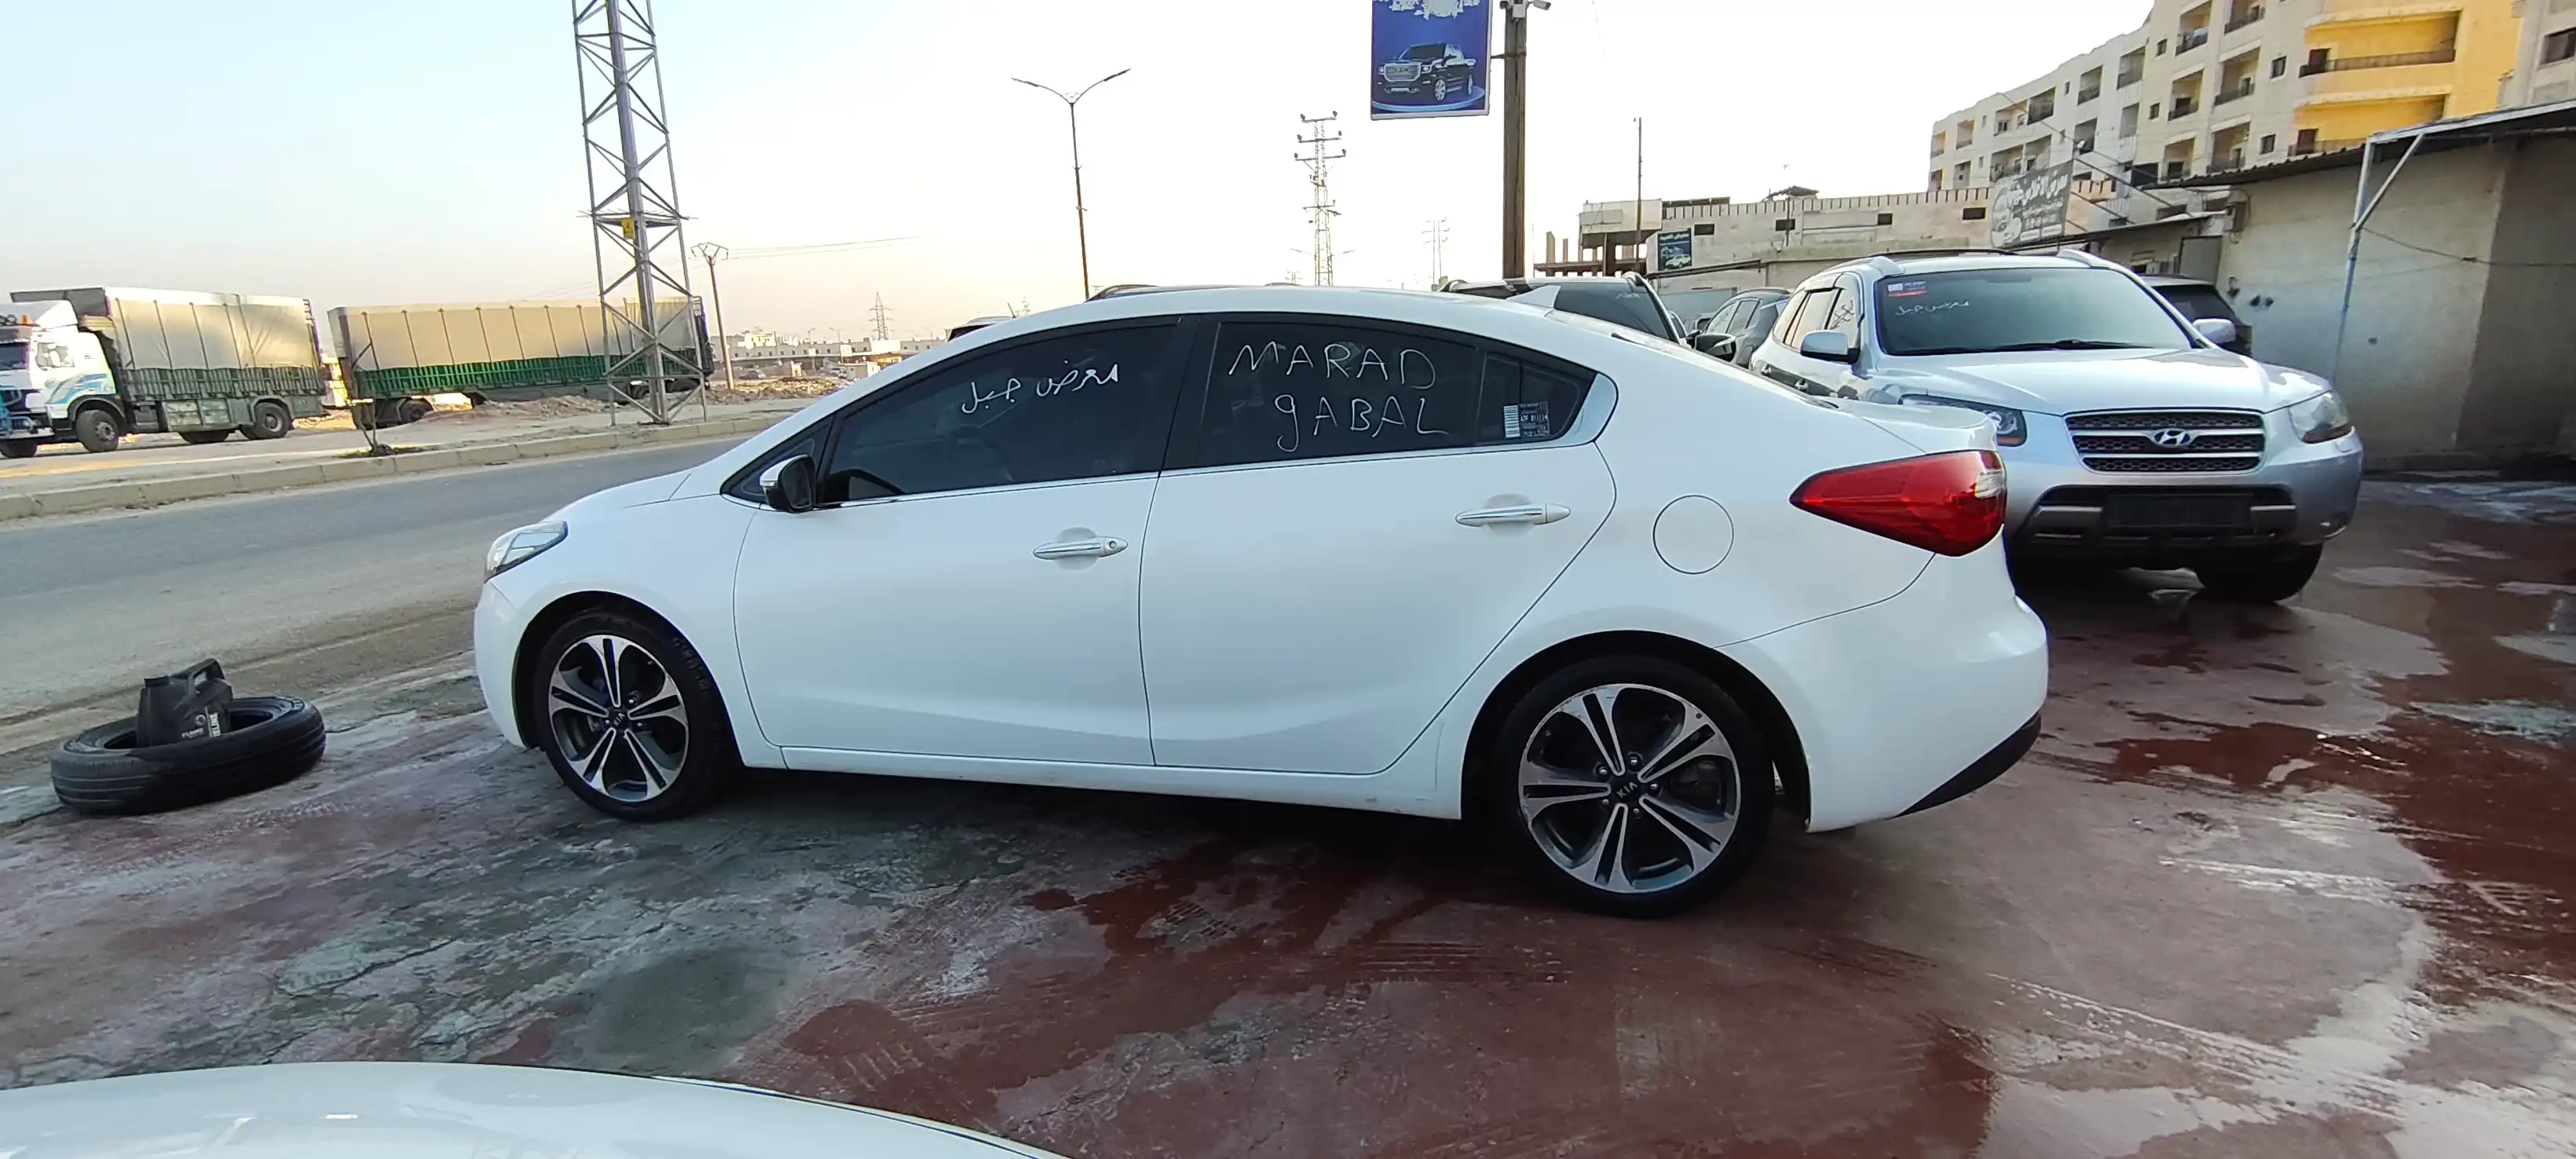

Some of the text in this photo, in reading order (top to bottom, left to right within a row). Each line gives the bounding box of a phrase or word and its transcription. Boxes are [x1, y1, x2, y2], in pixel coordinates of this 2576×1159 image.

[961, 359, 1118, 414] معرض جبل
[1228, 341, 1436, 389] MARAD
[1615, 781, 1639, 799] KIA
